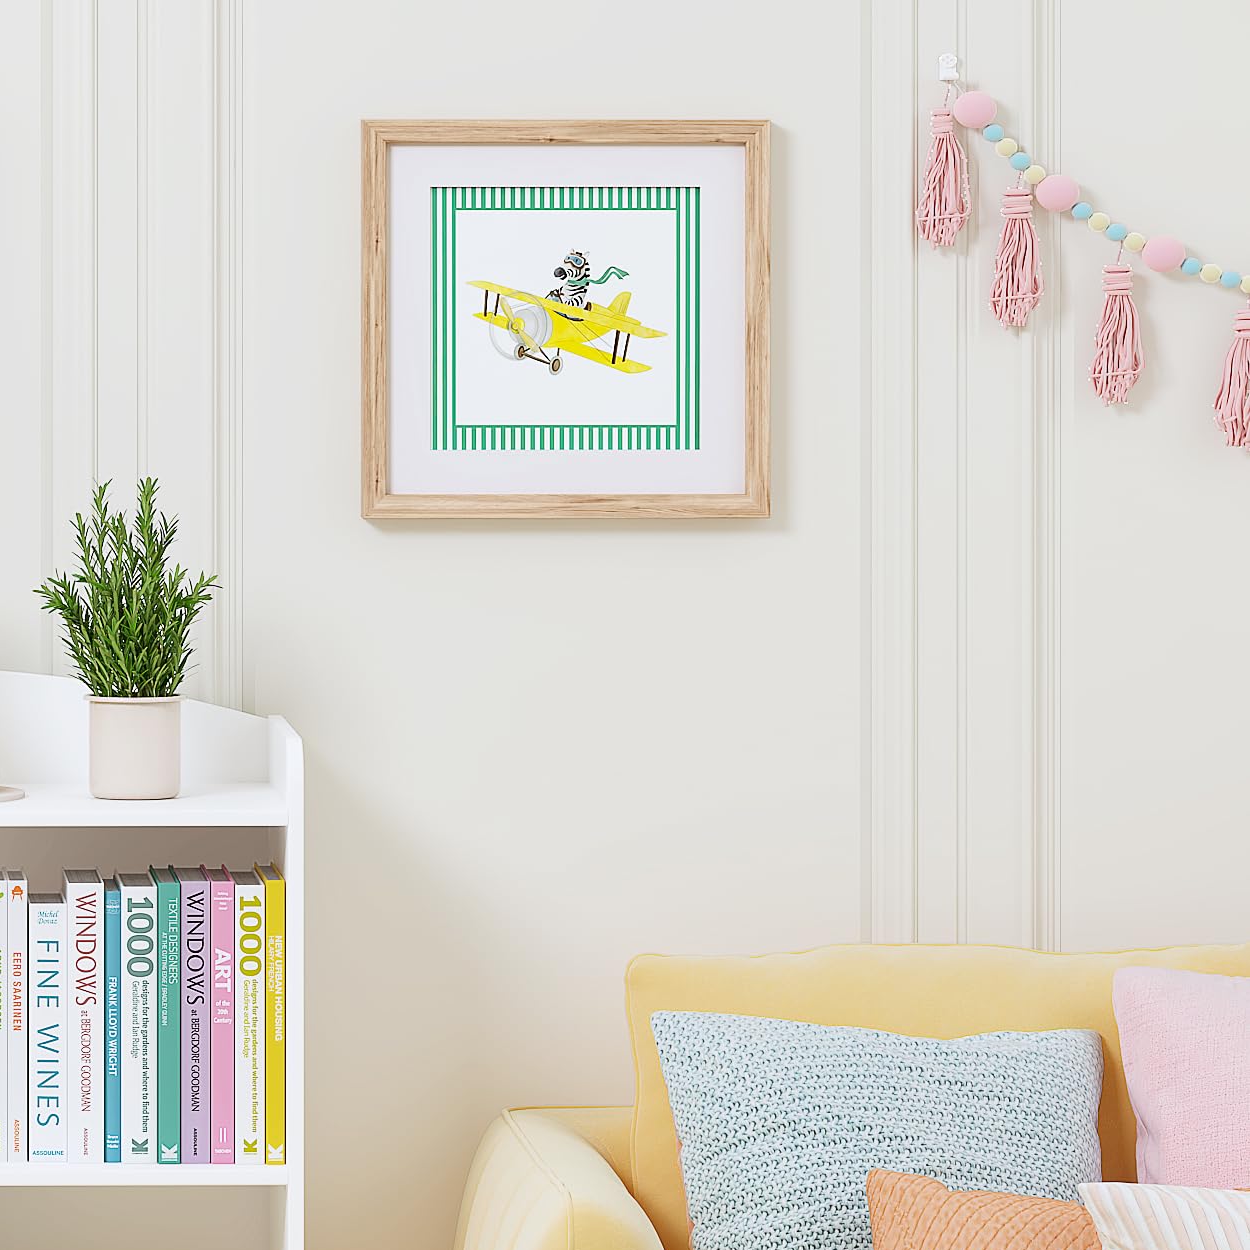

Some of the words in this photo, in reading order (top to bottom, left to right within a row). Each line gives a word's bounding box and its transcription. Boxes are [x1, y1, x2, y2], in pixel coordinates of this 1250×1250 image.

[168, 897, 178, 932] TEXTILE
[75, 891, 97, 1006] WINDOWS
[126, 896, 154, 977] 1000
[186, 890, 205, 1005] WINDOWS
[239, 895, 262, 977] 1000
[13, 952, 22, 978] EERO
[37, 940, 59, 1008] FINE
[168, 935, 178, 984] DESIGNERS
[214, 948, 231, 992] ART
[13, 981, 22, 1031] SAARINEN
[108, 976, 118, 1006] FRANK
[132, 981, 140, 1012] Geraldine
[141, 980, 149, 1006] designs
[108, 1007, 118, 1037] LLOYD
[132, 1013, 140, 1025] and
[192, 1009, 197, 1017] at
[214, 1017, 232, 1025] Century
[80, 1018, 91, 1064] BERGDORF
[132, 1026, 140, 1037] Ian
[140, 1029, 149, 1056] gardens
[191, 1018, 200, 1064] BERGDORF
[242, 1038, 250, 1058] Rudge
[250, 1029, 258, 1056] gardens
[108, 1038, 118, 1077] WRIGHT
[130, 1038, 140, 1059] Rudge
[37, 1023, 59, 1126] WINES
[80, 1065, 91, 1112] GOODMAN
[191, 1065, 200, 1112] GOODMAN
[142, 1092, 149, 1100] to
[252, 1092, 258, 1100] to
